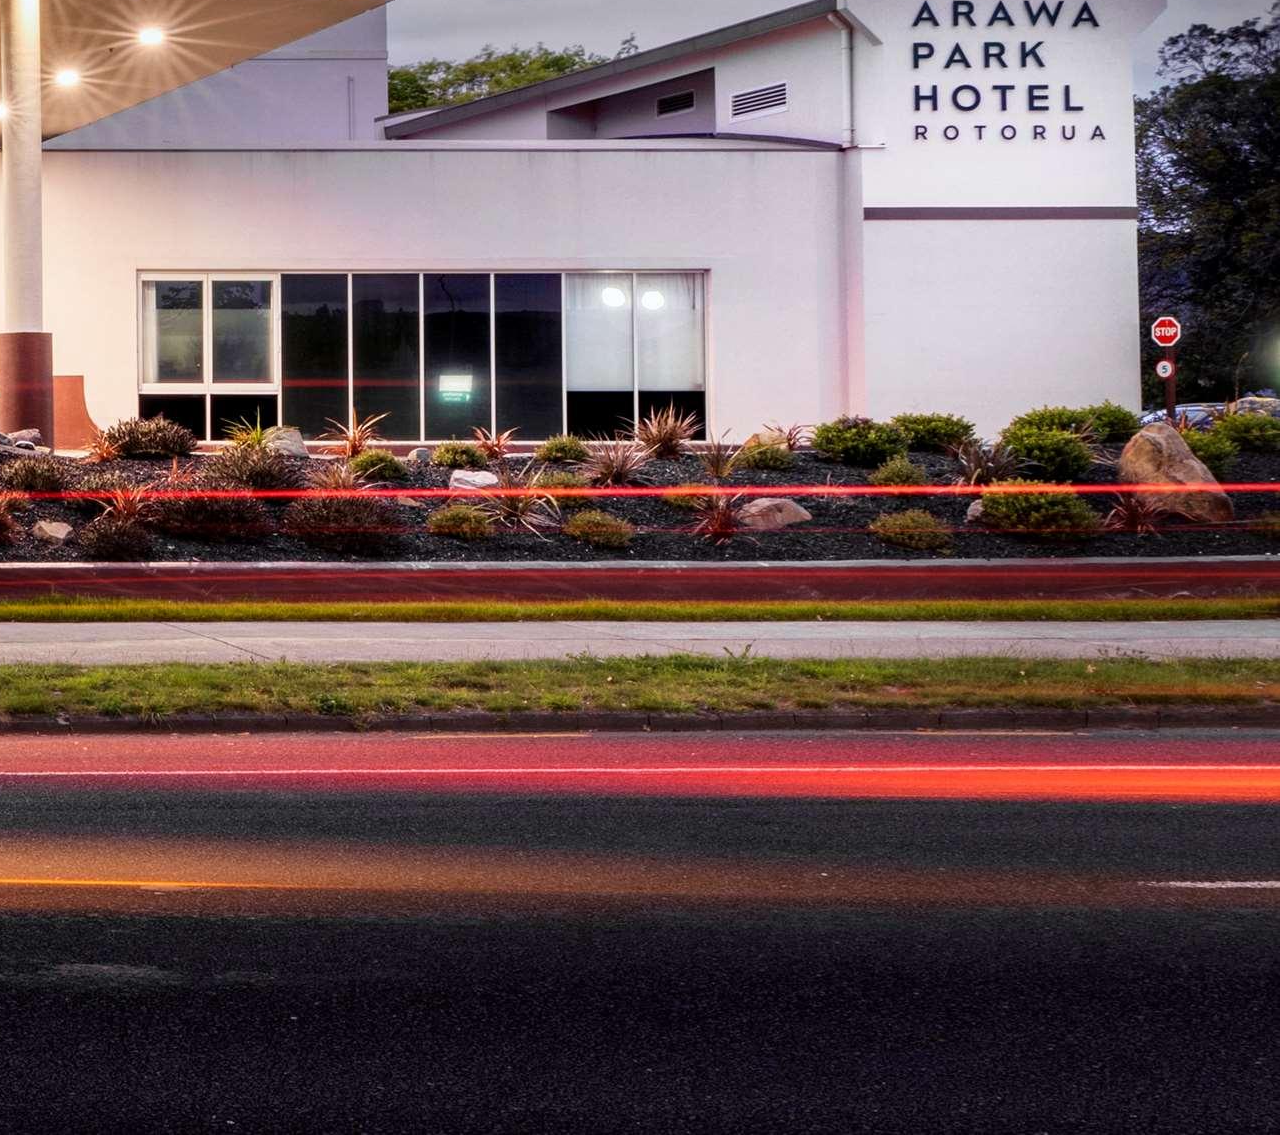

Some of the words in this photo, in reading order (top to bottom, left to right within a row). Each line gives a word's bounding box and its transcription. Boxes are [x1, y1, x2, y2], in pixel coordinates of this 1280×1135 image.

[911, 0, 1100, 27] ARAWA
[912, 41, 1046, 69] PARK
[913, 84, 1084, 112] HOTEL
[914, 124, 1106, 141] ROTORUA
[1154, 327, 1177, 337] STOP
[1161, 365, 1168, 373] 5
